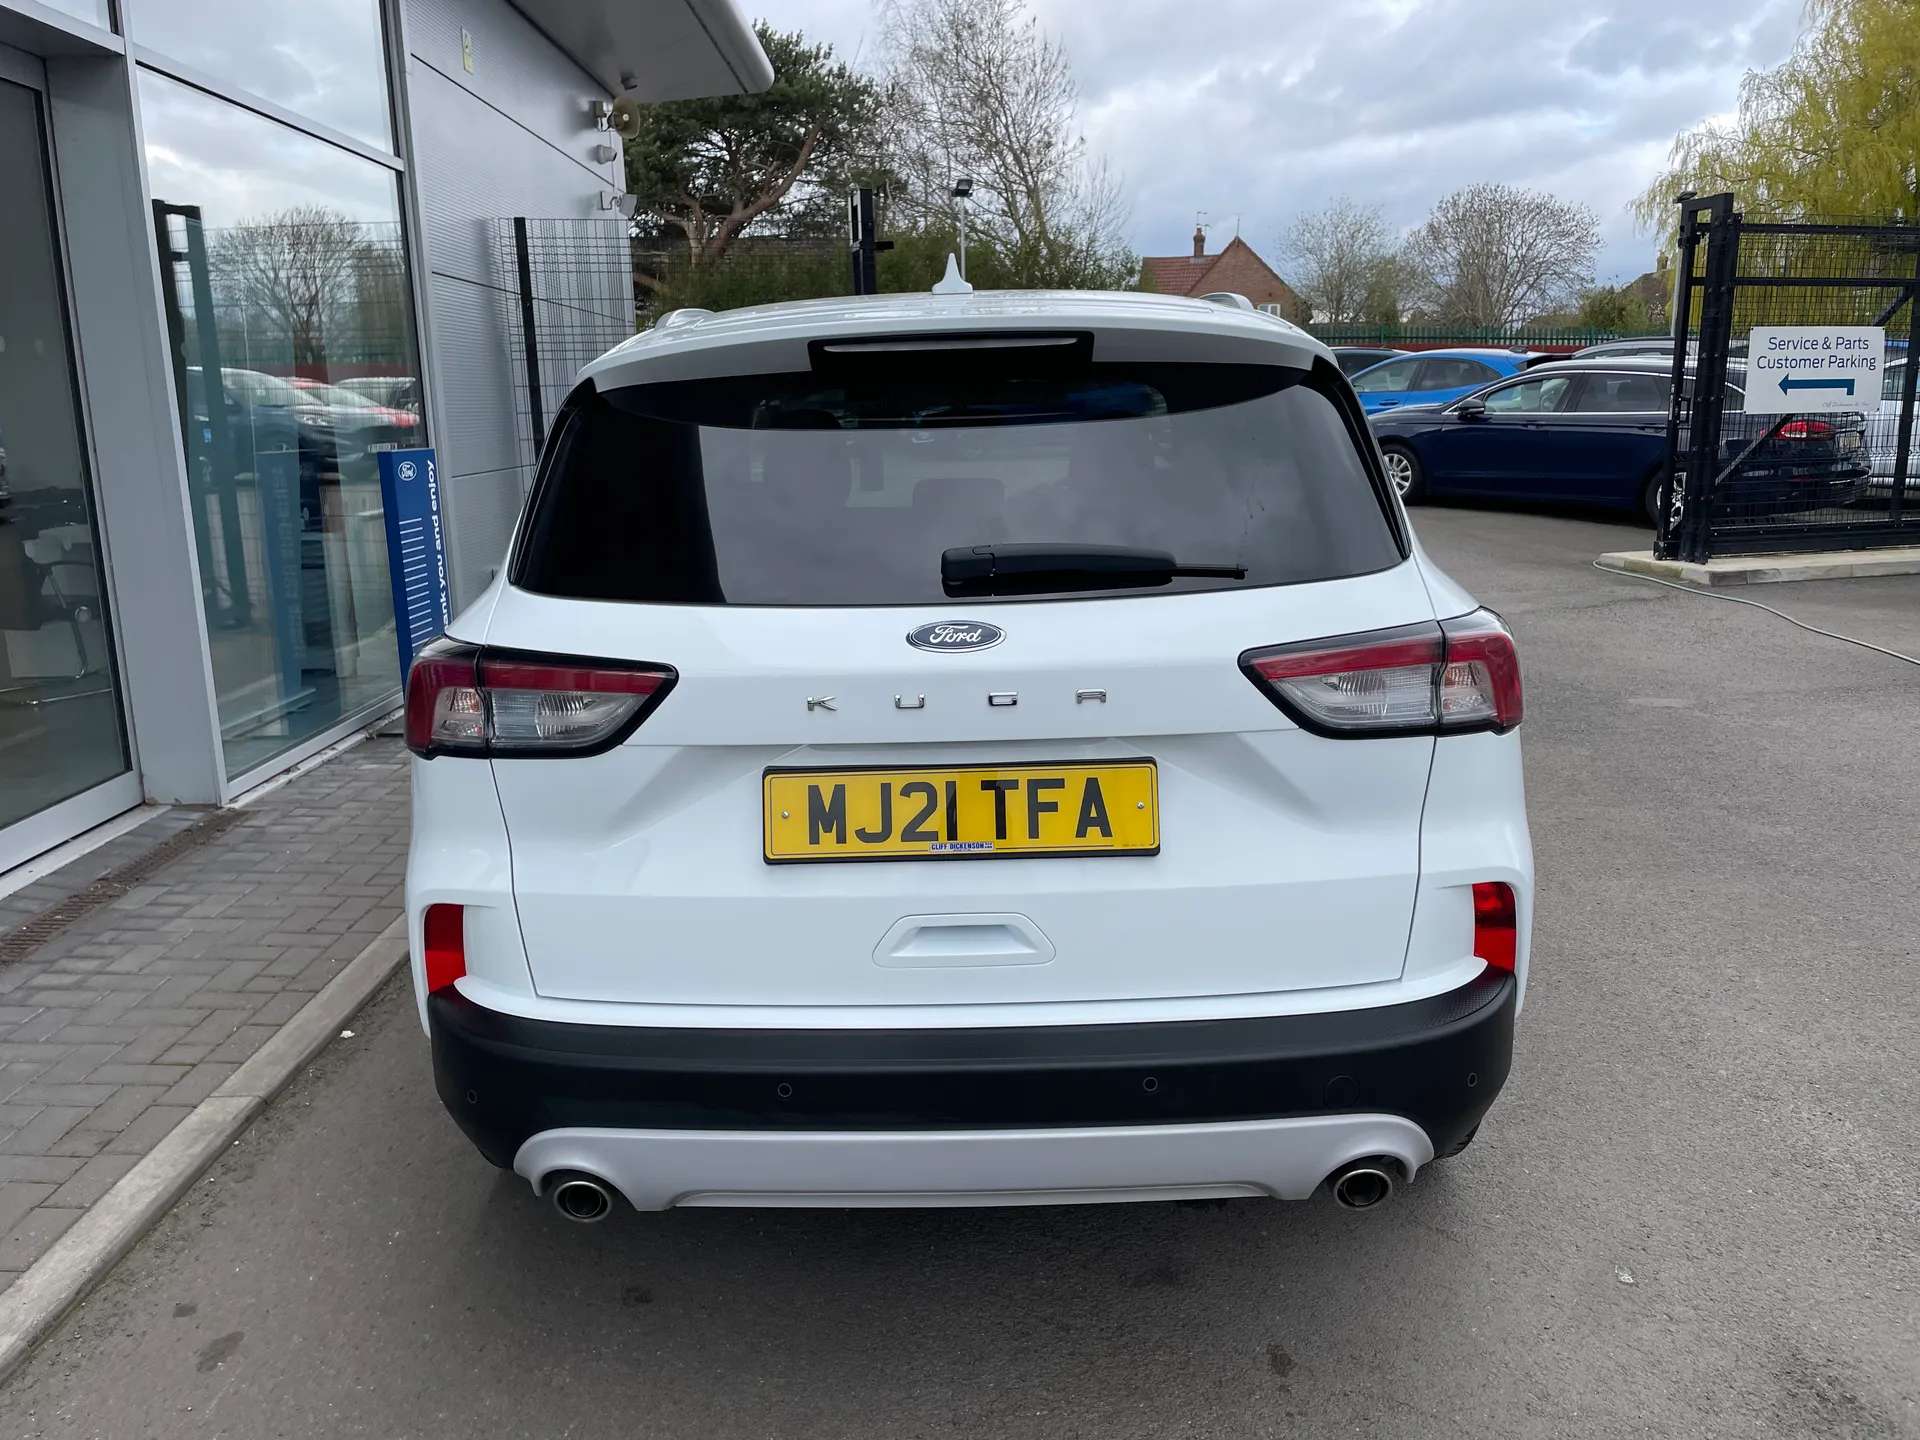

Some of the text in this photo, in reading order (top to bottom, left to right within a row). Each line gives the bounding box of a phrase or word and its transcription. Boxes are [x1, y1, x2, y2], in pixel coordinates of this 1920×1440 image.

[1768, 336, 1869, 350] Service & Parts
[1757, 354, 1876, 371] Customer Parking
[427, 460, 449, 631] ank you and enjoy
[929, 625, 982, 645] Ford
[806, 687, 1108, 713] KUGA
[807, 776, 1113, 845] MJ21 TFA
[949, 842, 985, 850] DICKENSON
